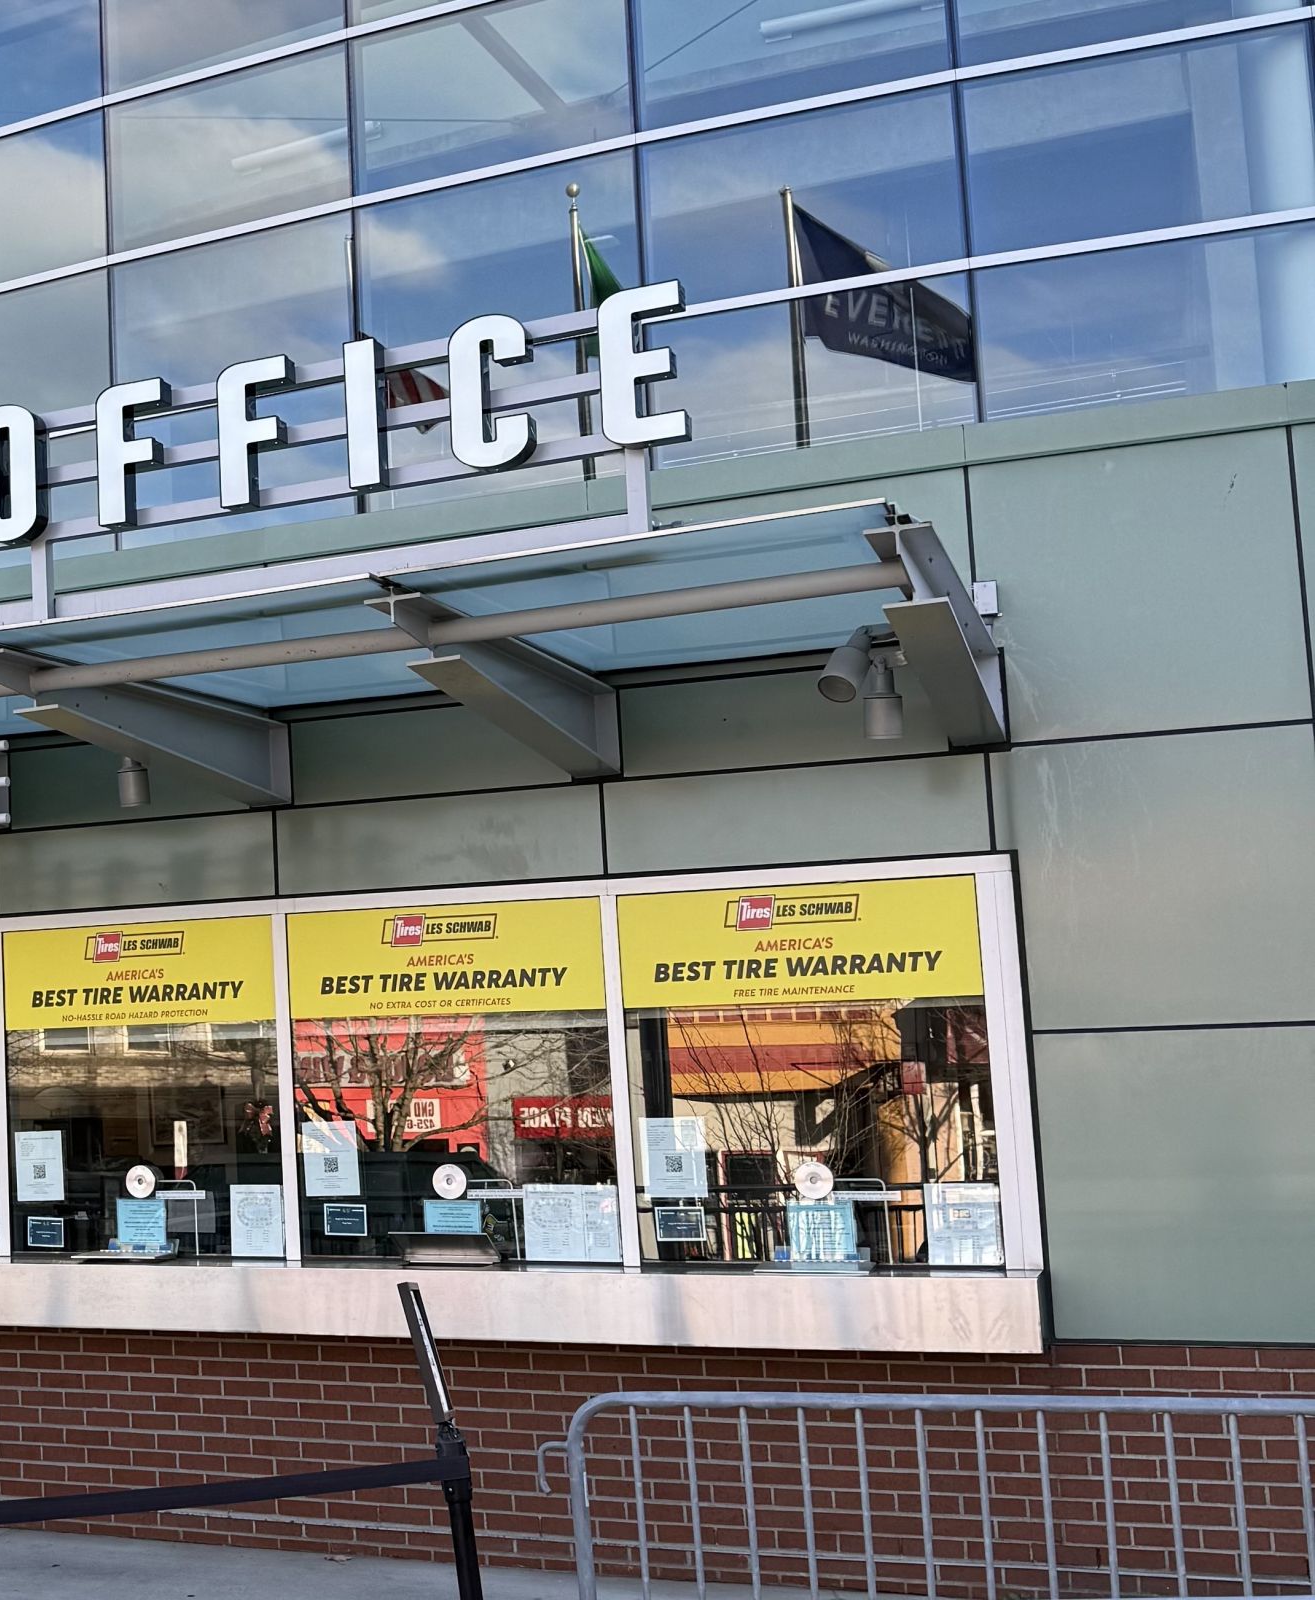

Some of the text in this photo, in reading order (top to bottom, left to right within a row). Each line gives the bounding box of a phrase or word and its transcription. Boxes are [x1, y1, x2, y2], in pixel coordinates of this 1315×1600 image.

[741, 902, 771, 921] Tires
[776, 901, 852, 917] LES SCHWAB
[396, 920, 421, 938] Tires
[426, 920, 492, 934] LES SCHWAB
[97, 938, 119, 954] Tires
[123, 937, 179, 951] LES SCHWAB
[754, 937, 834, 952] AMERICA'S
[407, 954, 474, 967] AMERICA'S
[654, 950, 943, 983] BEST TIRE WARRANTY
[106, 968, 164, 982] AMERICA'S
[320, 967, 568, 995] BEST TIRE WARRANTY
[32, 980, 244, 1008] BEST TIRE WARRANTY
[733, 985, 855, 997] FREE TIRE MAINTENANCE
[370, 997, 511, 1010] NO EXTRA COST OR CERTIFICATES
[62, 1009, 208, 1022] NO-HASSLE ROAD HAZARD PROTECTION
